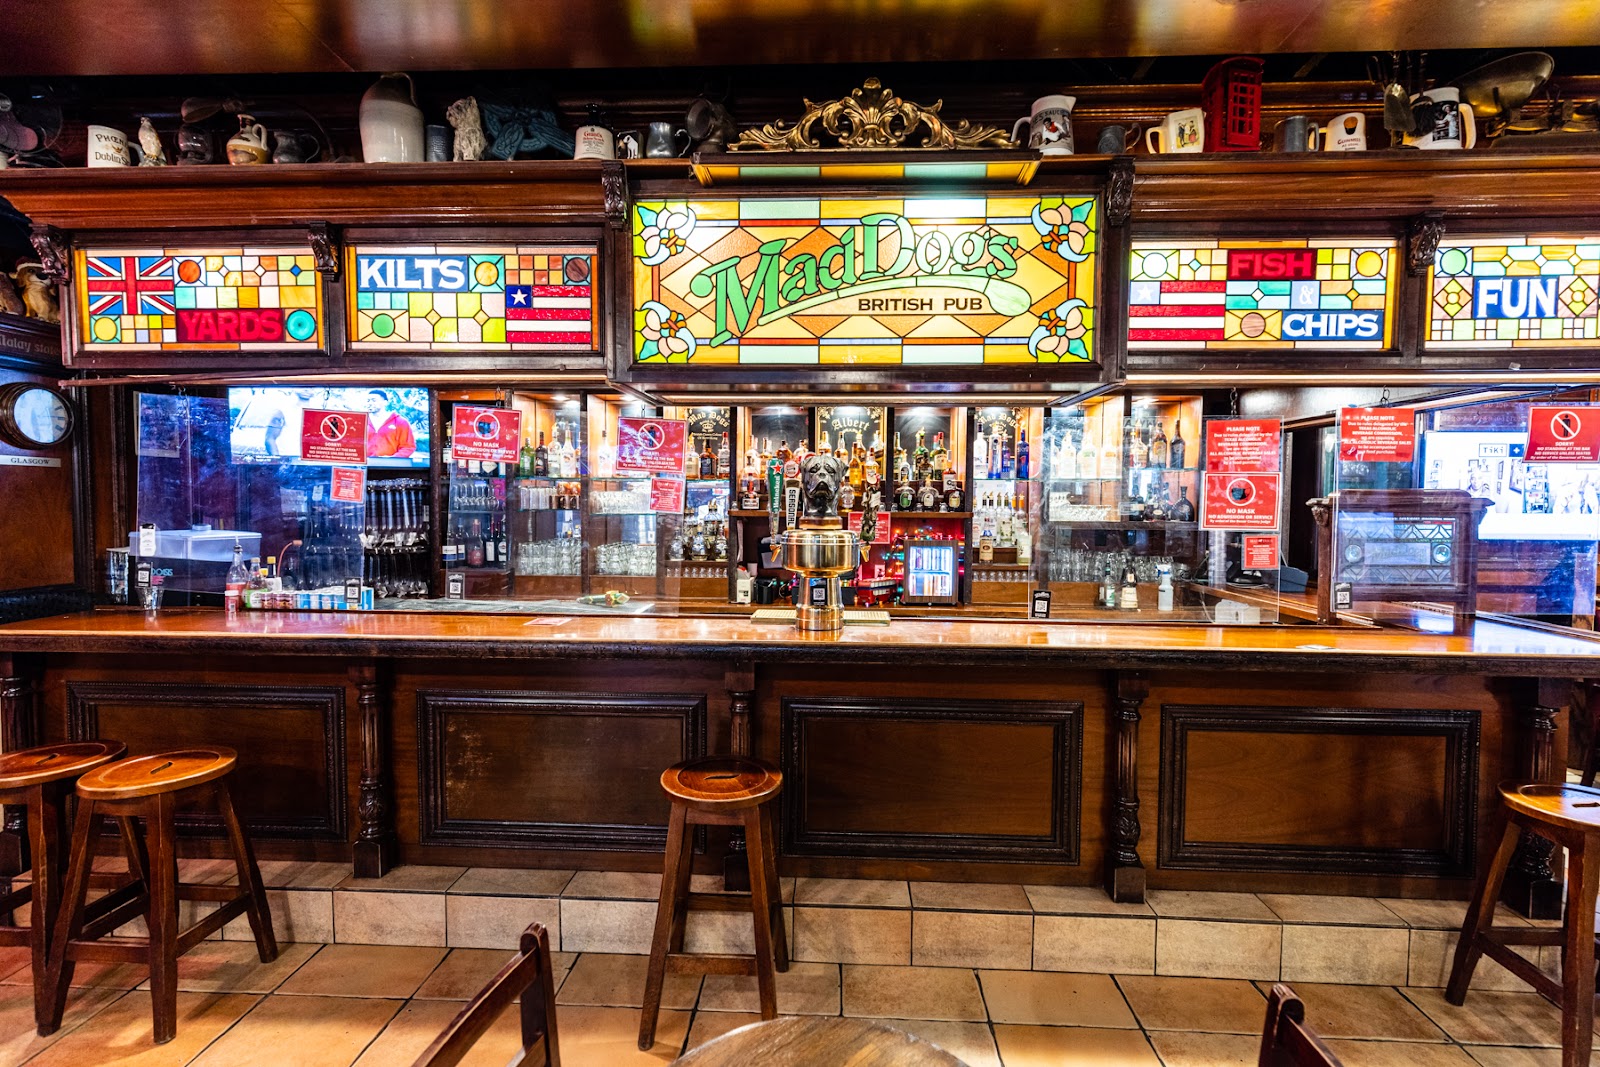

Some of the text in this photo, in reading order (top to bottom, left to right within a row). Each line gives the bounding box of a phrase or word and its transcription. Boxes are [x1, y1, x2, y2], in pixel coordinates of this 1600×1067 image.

[359, 258, 466, 290] KILTS
[1230, 252, 1314, 278] FISH
[690, 227, 858, 348] Mad
[1299, 285, 1314, 305] &
[1476, 277, 1558, 319] FUN
[857, 298, 983, 312] BRITISH PUB
[179, 310, 283, 342] YARDS
[1282, 313, 1379, 338] CHIPS
[689, 411, 706, 426] Mad
[709, 411, 730, 428] Dogs
[831, 416, 870, 431] Albert
[10, 457, 50, 465] GLASGOW
[773, 475, 781, 509] Heineken
[788, 489, 797, 526] SEASONAL
